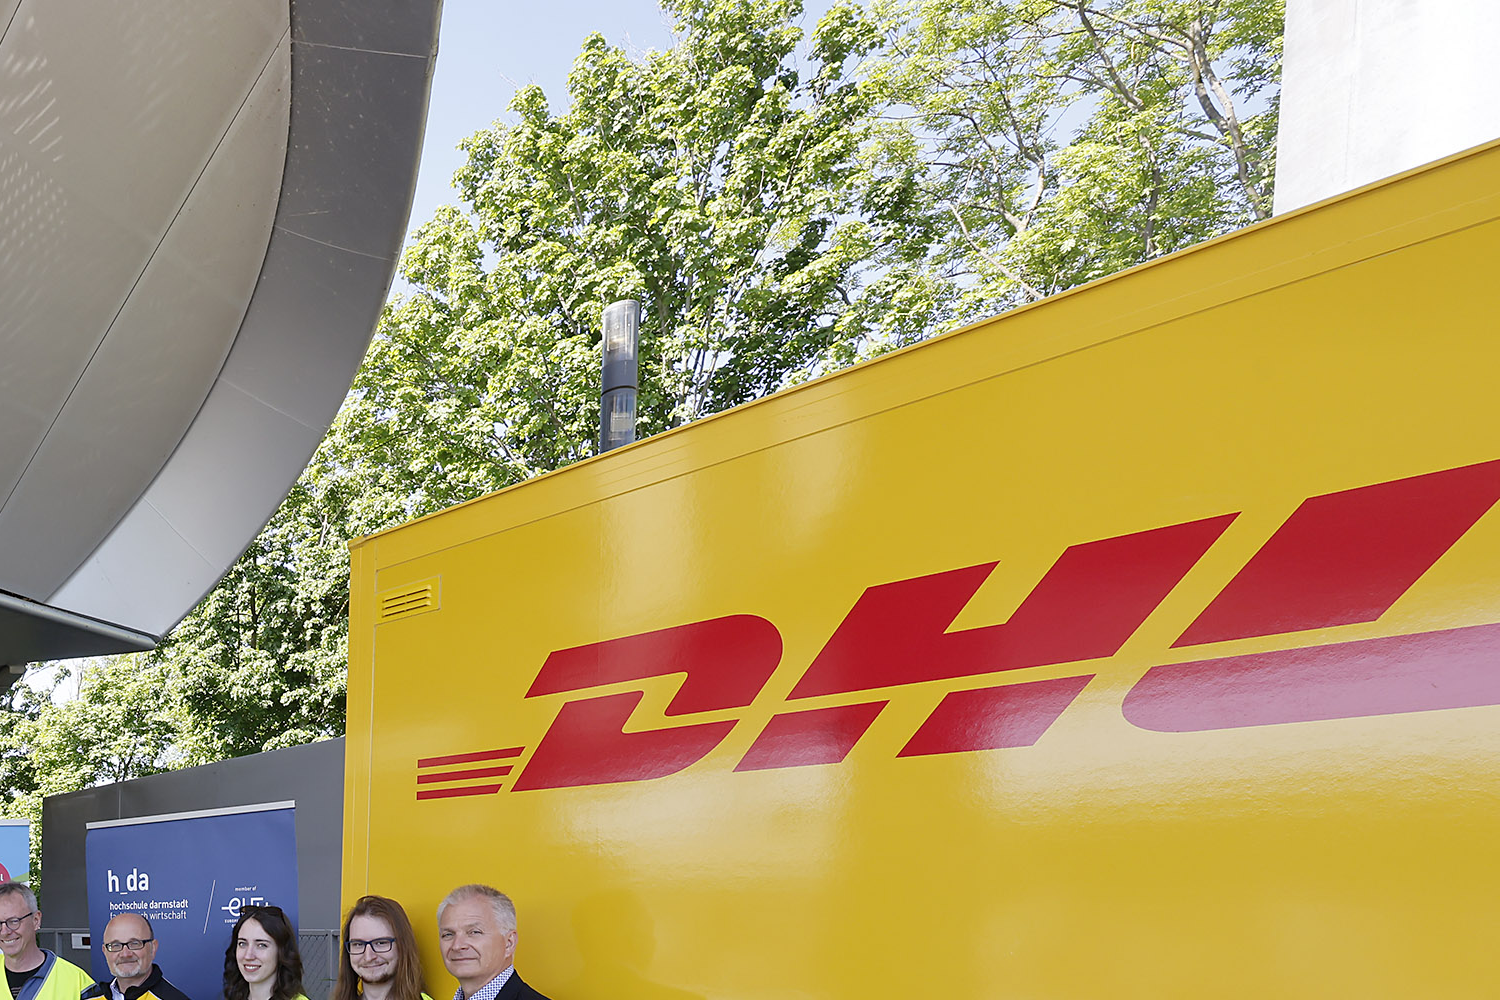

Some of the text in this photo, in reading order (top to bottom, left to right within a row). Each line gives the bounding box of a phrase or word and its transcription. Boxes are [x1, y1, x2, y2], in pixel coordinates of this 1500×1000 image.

[510, 458, 1500, 792] DHL
[108, 868, 148, 895] h_da
[110, 899, 188, 910] hochschule darmstadt
[150, 910, 186, 920] wirtschaft
